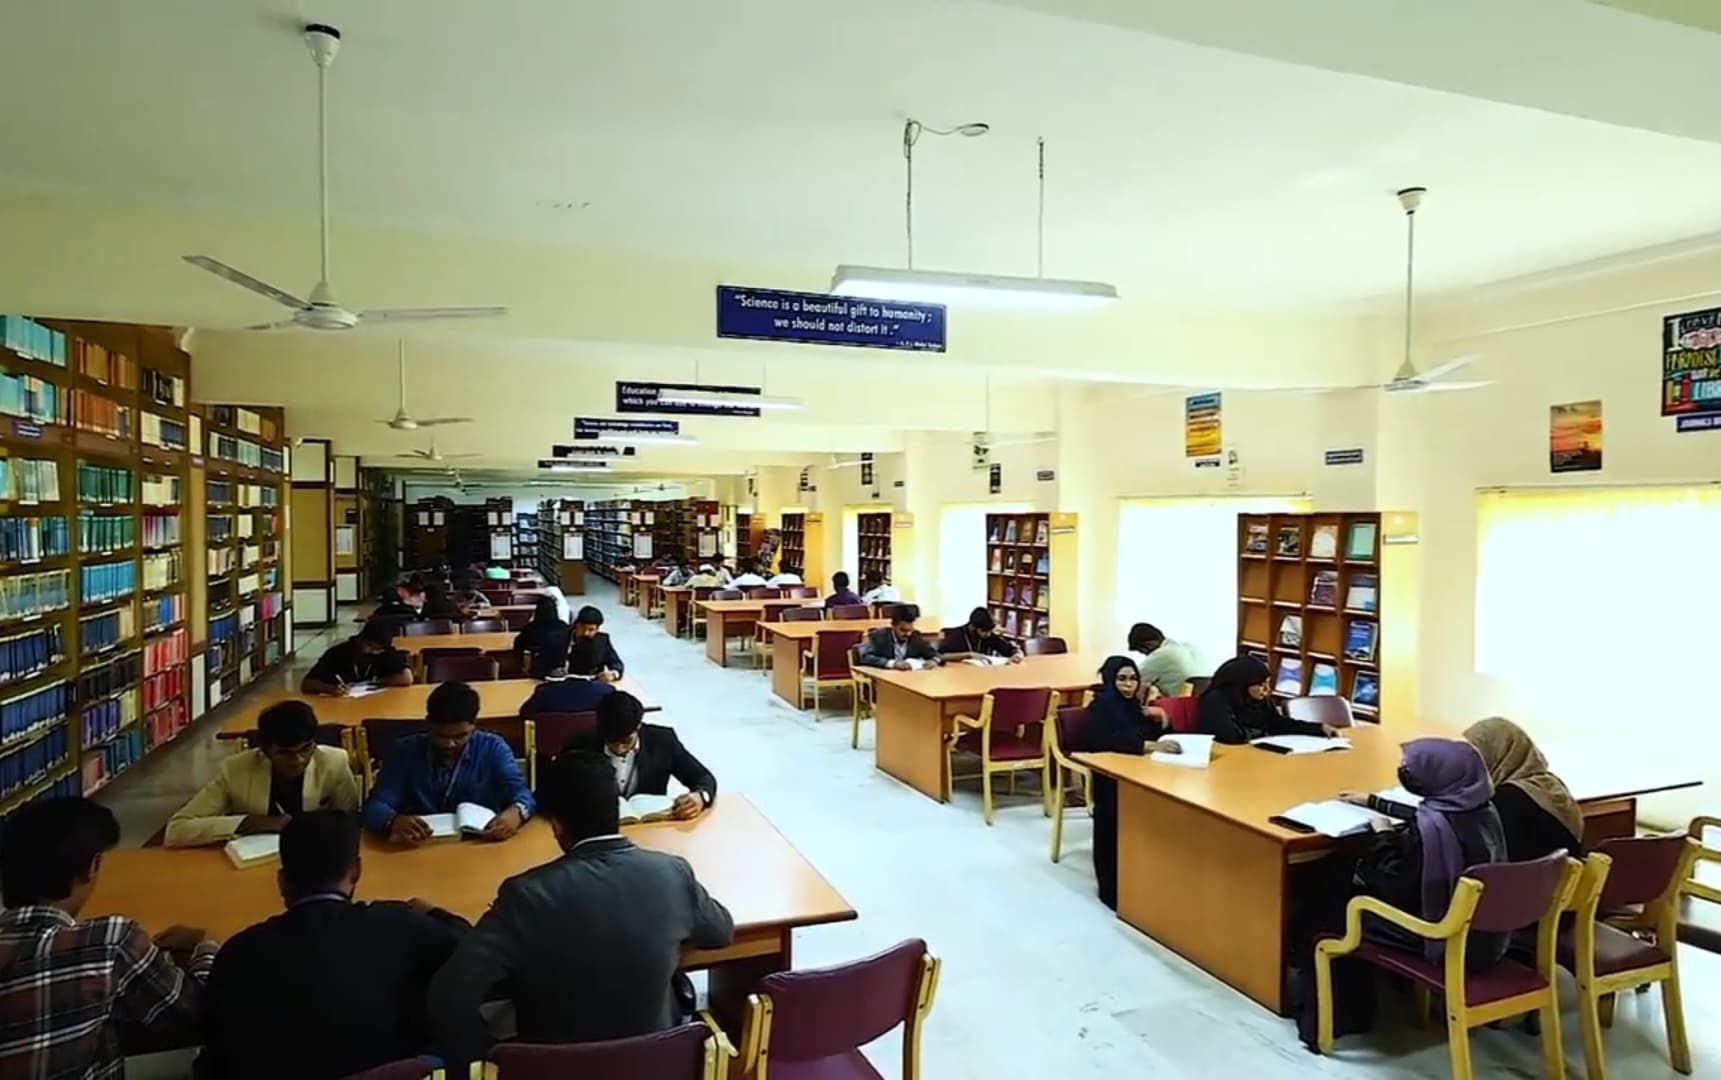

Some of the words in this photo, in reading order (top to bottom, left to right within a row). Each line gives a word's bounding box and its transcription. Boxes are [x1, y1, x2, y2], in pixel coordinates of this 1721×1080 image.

[781, 298, 790, 310] is
[792, 302, 800, 311] a
[802, 299, 848, 315] beautiful
[850, 303, 867, 319] gift
[869, 306, 880, 318] to
[774, 318, 789, 328] we
[791, 316, 825, 331] should
[828, 321, 844, 332] not
[847, 320, 878, 335] distort
[621, 385, 657, 395] Education
[622, 397, 644, 406] which
[646, 399, 658, 407] you
